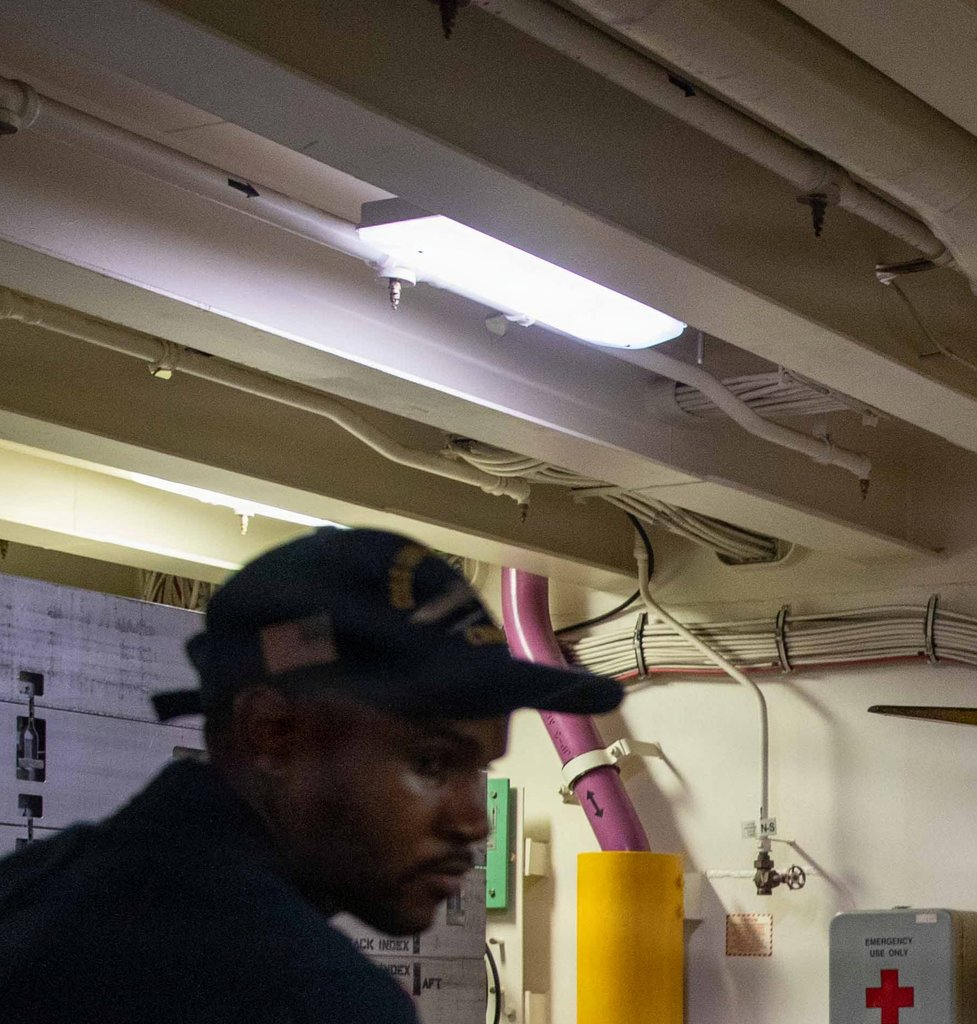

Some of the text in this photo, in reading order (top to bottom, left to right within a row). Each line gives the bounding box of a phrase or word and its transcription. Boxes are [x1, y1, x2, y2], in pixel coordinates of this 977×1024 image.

[379, 939, 409, 951] INDEX
[864, 936, 914, 947] EMERGENCY
[869, 948, 909, 958] USE ONLY
[422, 977, 442, 990] AFT
